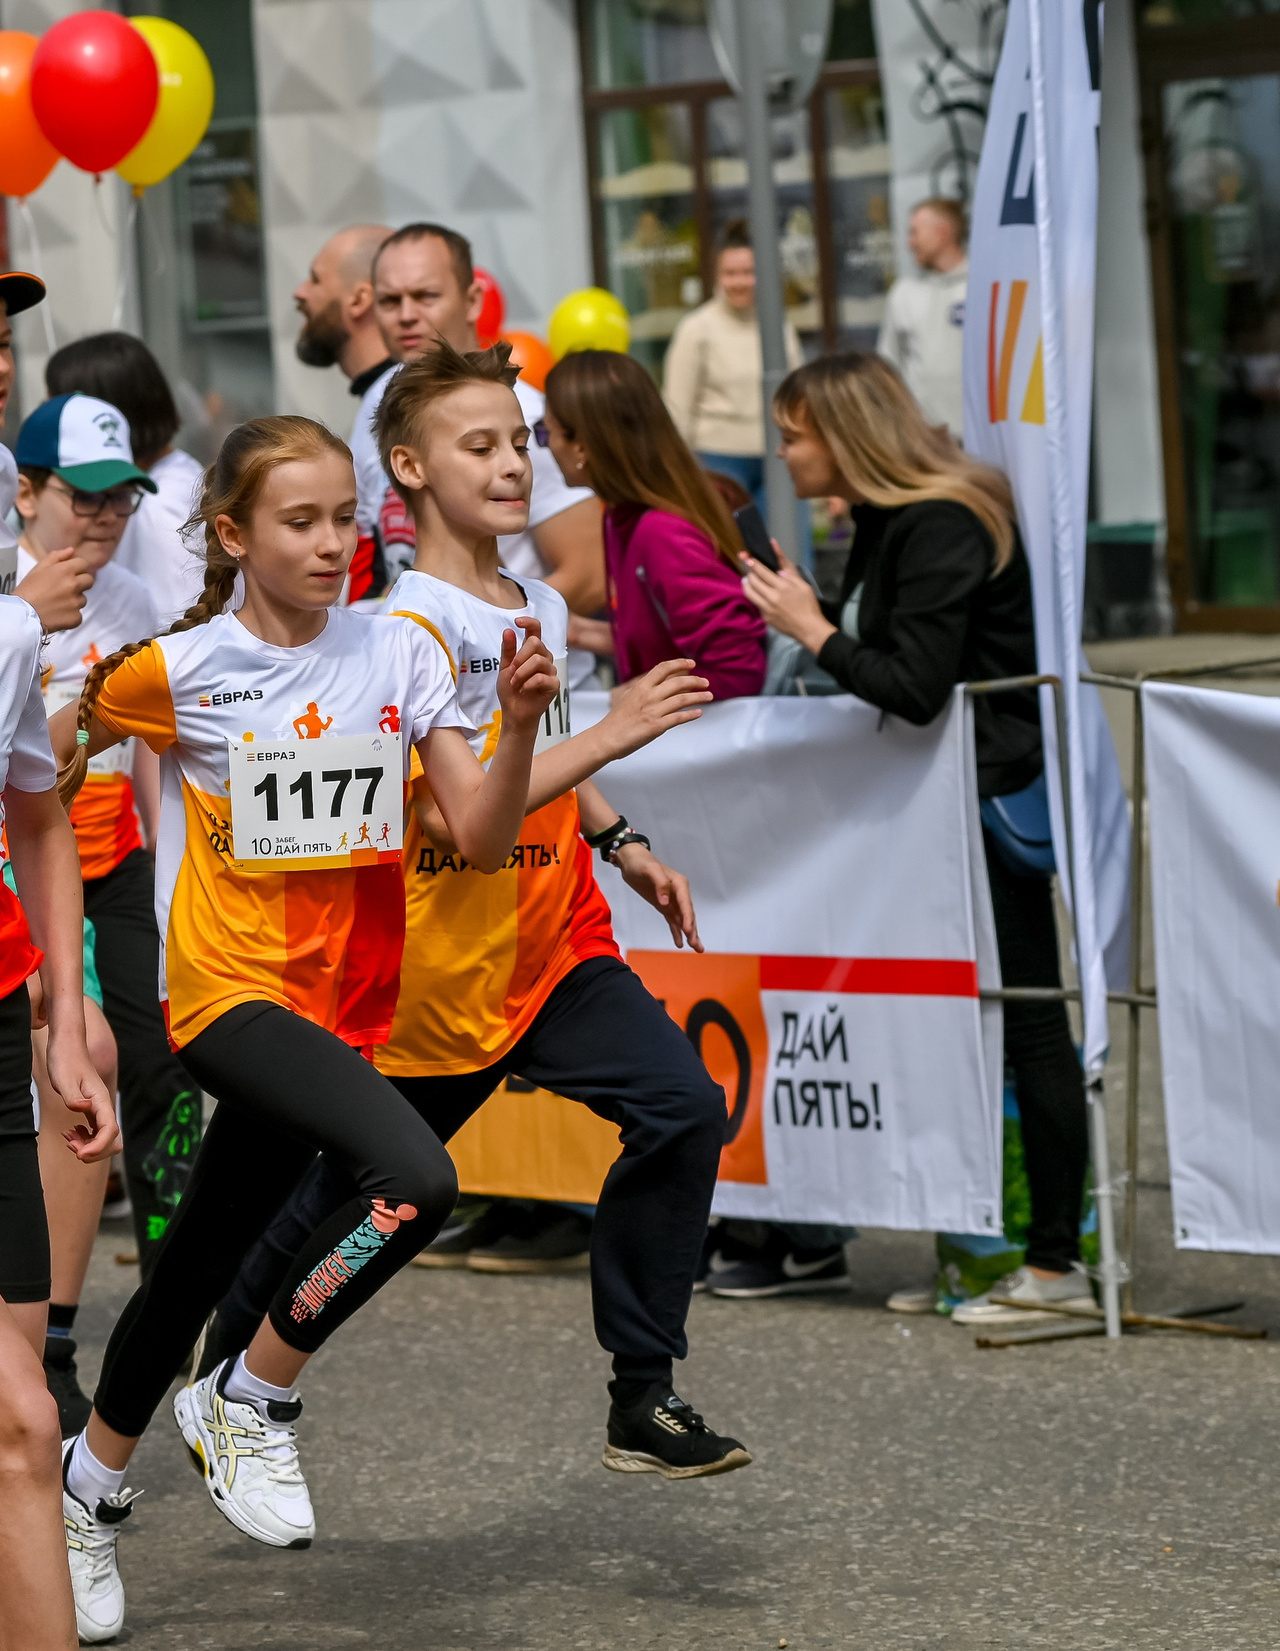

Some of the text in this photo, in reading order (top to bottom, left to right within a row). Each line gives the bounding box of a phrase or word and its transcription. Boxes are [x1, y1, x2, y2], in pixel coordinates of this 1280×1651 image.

[470, 657, 499, 674] ЕВР
[212, 690, 263, 706] ЕВРАЗ
[257, 751, 296, 762] ЕВРАЗ
[254, 767, 384, 821] 1177
[251, 838, 332, 856] 10 ДАЙ ПЯТЬ
[275, 836, 296, 844] ЗАБЕГ
[775, 1003, 849, 1069] ДАЙ
[774, 1077, 883, 1131] ПЯТЬ!
[299, 1249, 353, 1312] MICKEY
